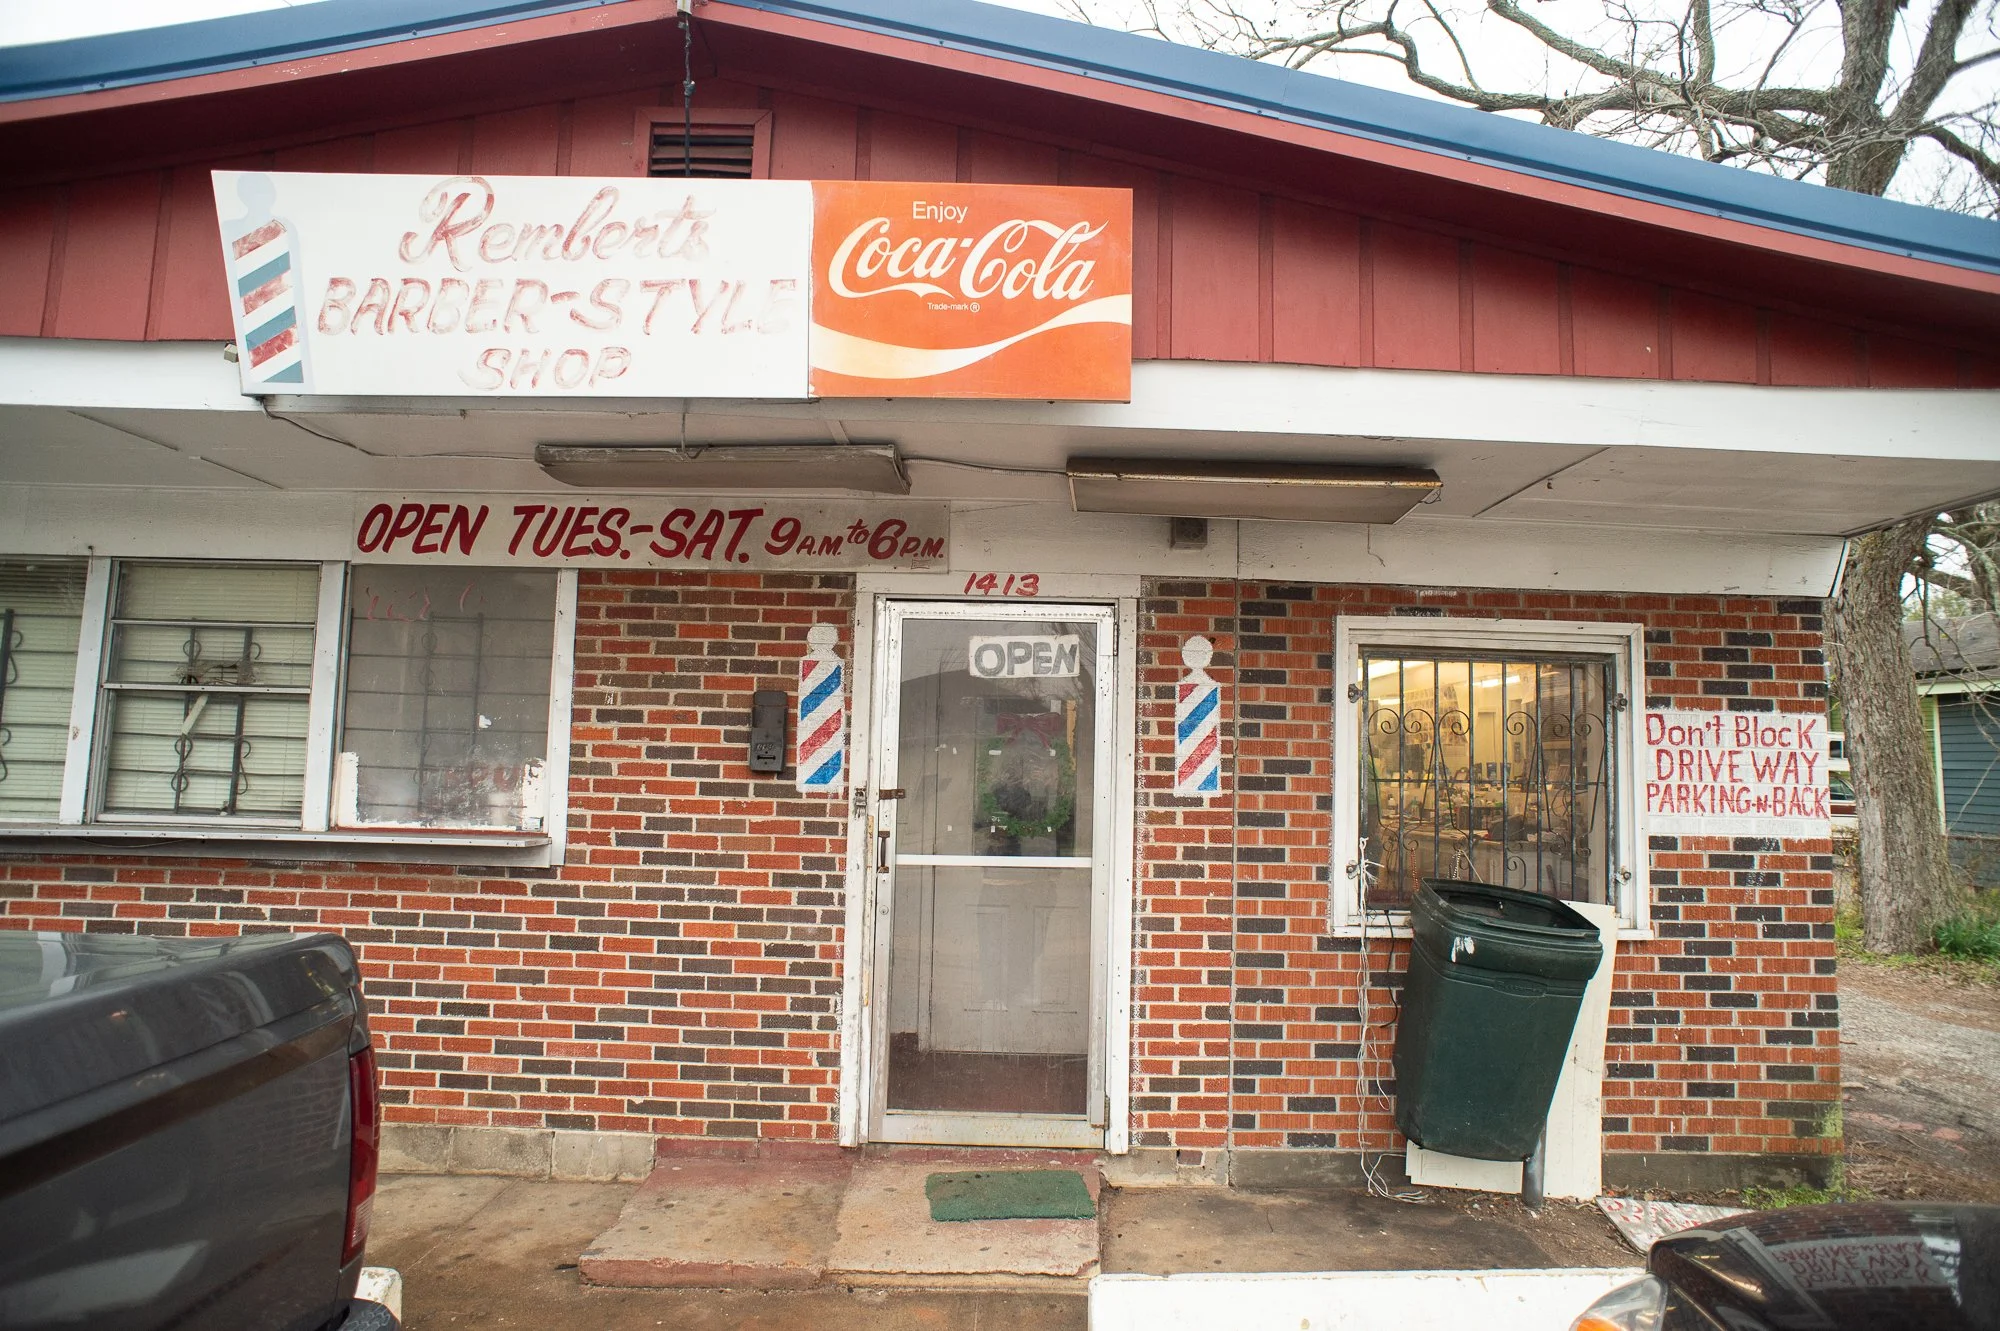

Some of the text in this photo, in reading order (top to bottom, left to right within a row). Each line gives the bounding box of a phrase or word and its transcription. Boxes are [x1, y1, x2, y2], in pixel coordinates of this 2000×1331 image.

[912, 201, 968, 223] Enjoy
[828, 216, 1109, 300] Coca-Cola
[316, 276, 797, 336] BARBER-STYLE
[457, 346, 631, 391] SHOP
[357, 503, 489, 556] OPEN
[846, 518, 870, 545] to
[964, 573, 1040, 597] 1413
[974, 641, 1079, 676] OPEN
[1645, 713, 1725, 747] Don't
